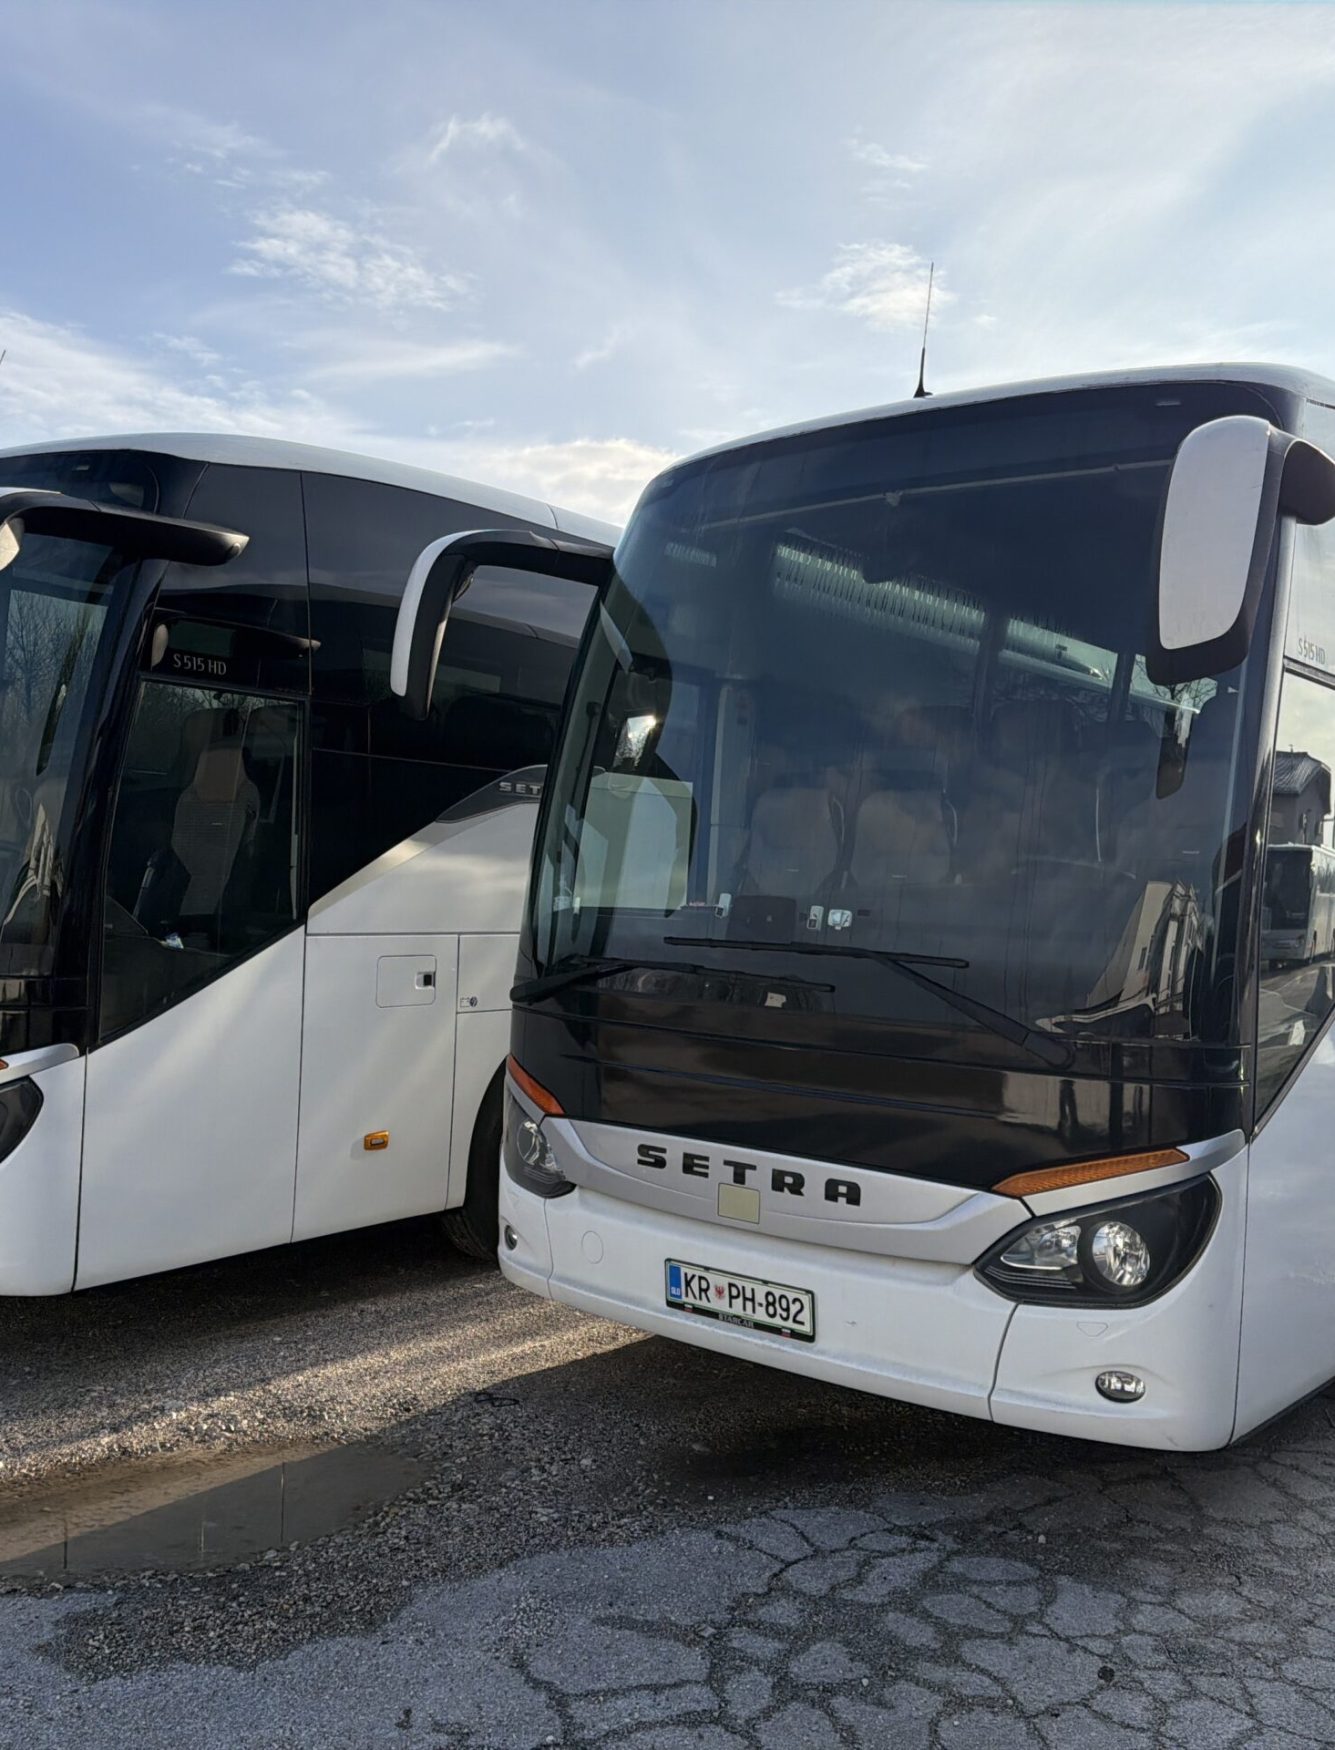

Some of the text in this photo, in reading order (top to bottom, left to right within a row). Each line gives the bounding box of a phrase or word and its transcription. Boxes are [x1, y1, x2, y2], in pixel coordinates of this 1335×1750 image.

[173, 653, 227, 675] S 515 HD
[637, 1143, 862, 1207] SETRA
[684, 1272, 711, 1304] KR
[728, 1282, 806, 1327] PH-892
